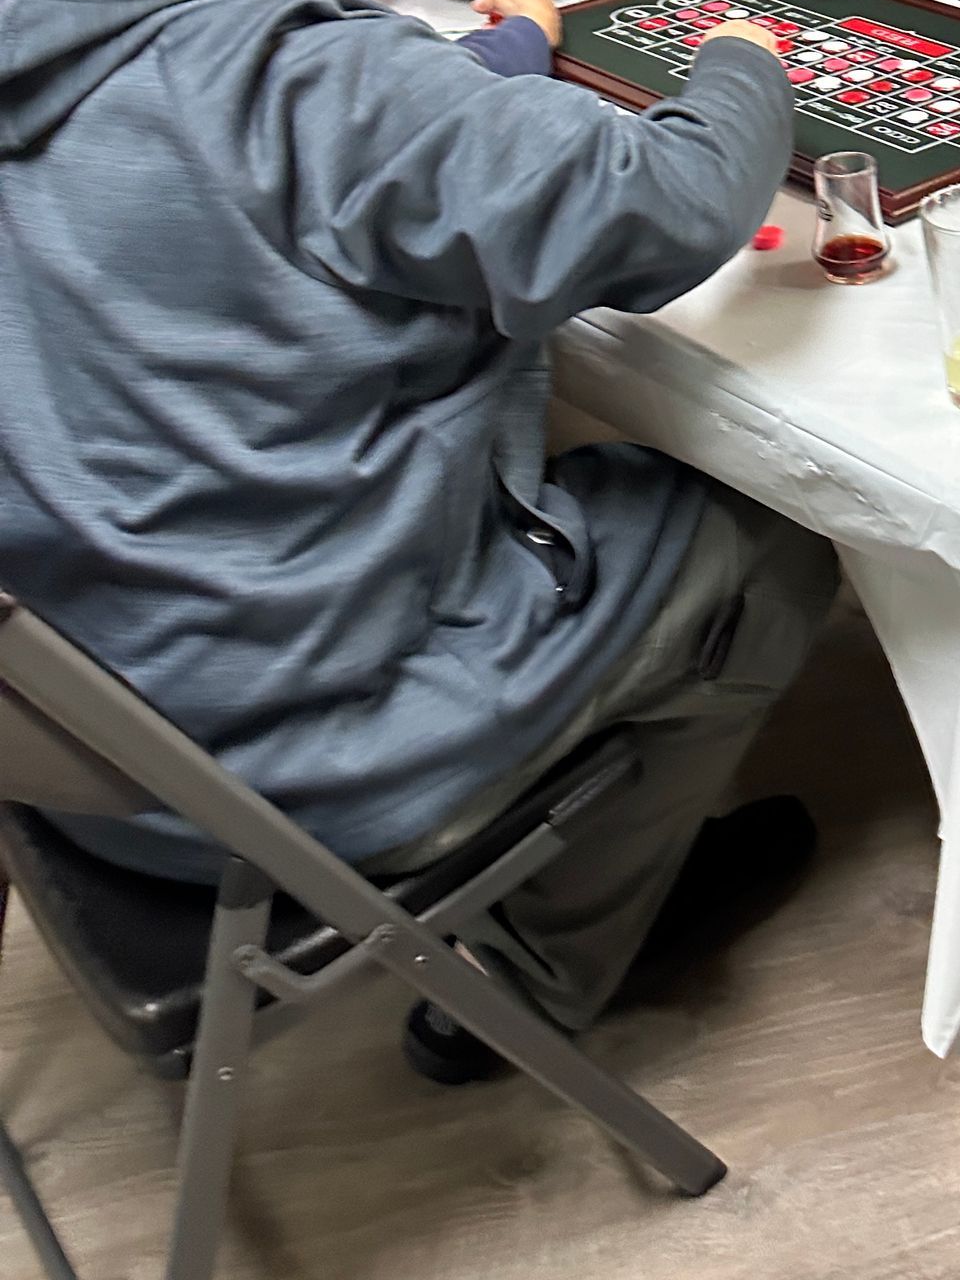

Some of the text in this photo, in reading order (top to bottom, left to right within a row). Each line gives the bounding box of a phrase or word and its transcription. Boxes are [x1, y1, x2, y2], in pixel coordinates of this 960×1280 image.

[667, 28, 685, 36] 4
[870, 28, 919, 46] RED
[866, 101, 899, 114] 28
[872, 125, 921, 144] ODD
